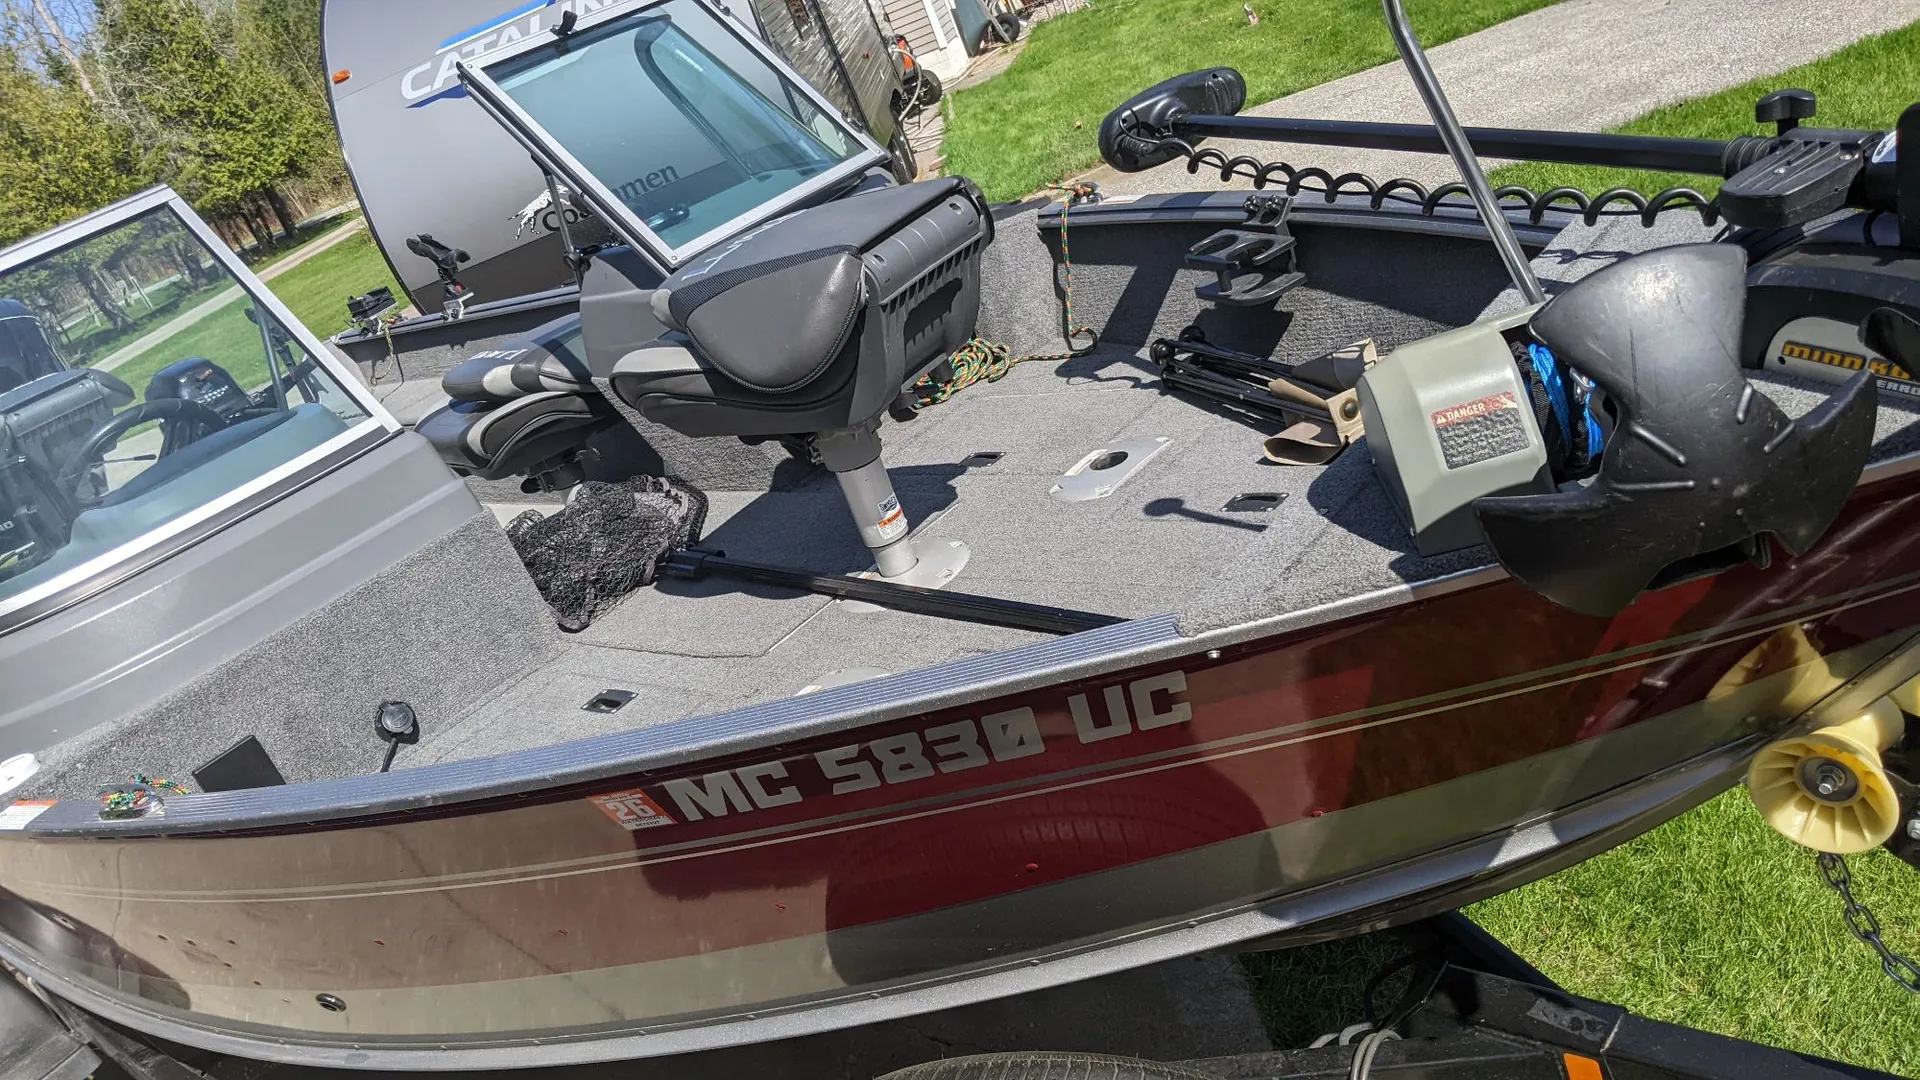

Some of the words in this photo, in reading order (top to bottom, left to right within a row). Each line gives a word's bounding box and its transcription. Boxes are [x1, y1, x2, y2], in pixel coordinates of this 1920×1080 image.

[1446, 402, 1486, 421] DANGER
[662, 760, 803, 822] MC
[814, 706, 1046, 795] 5830
[1067, 669, 1193, 745] UC
[605, 798, 657, 821] 26
